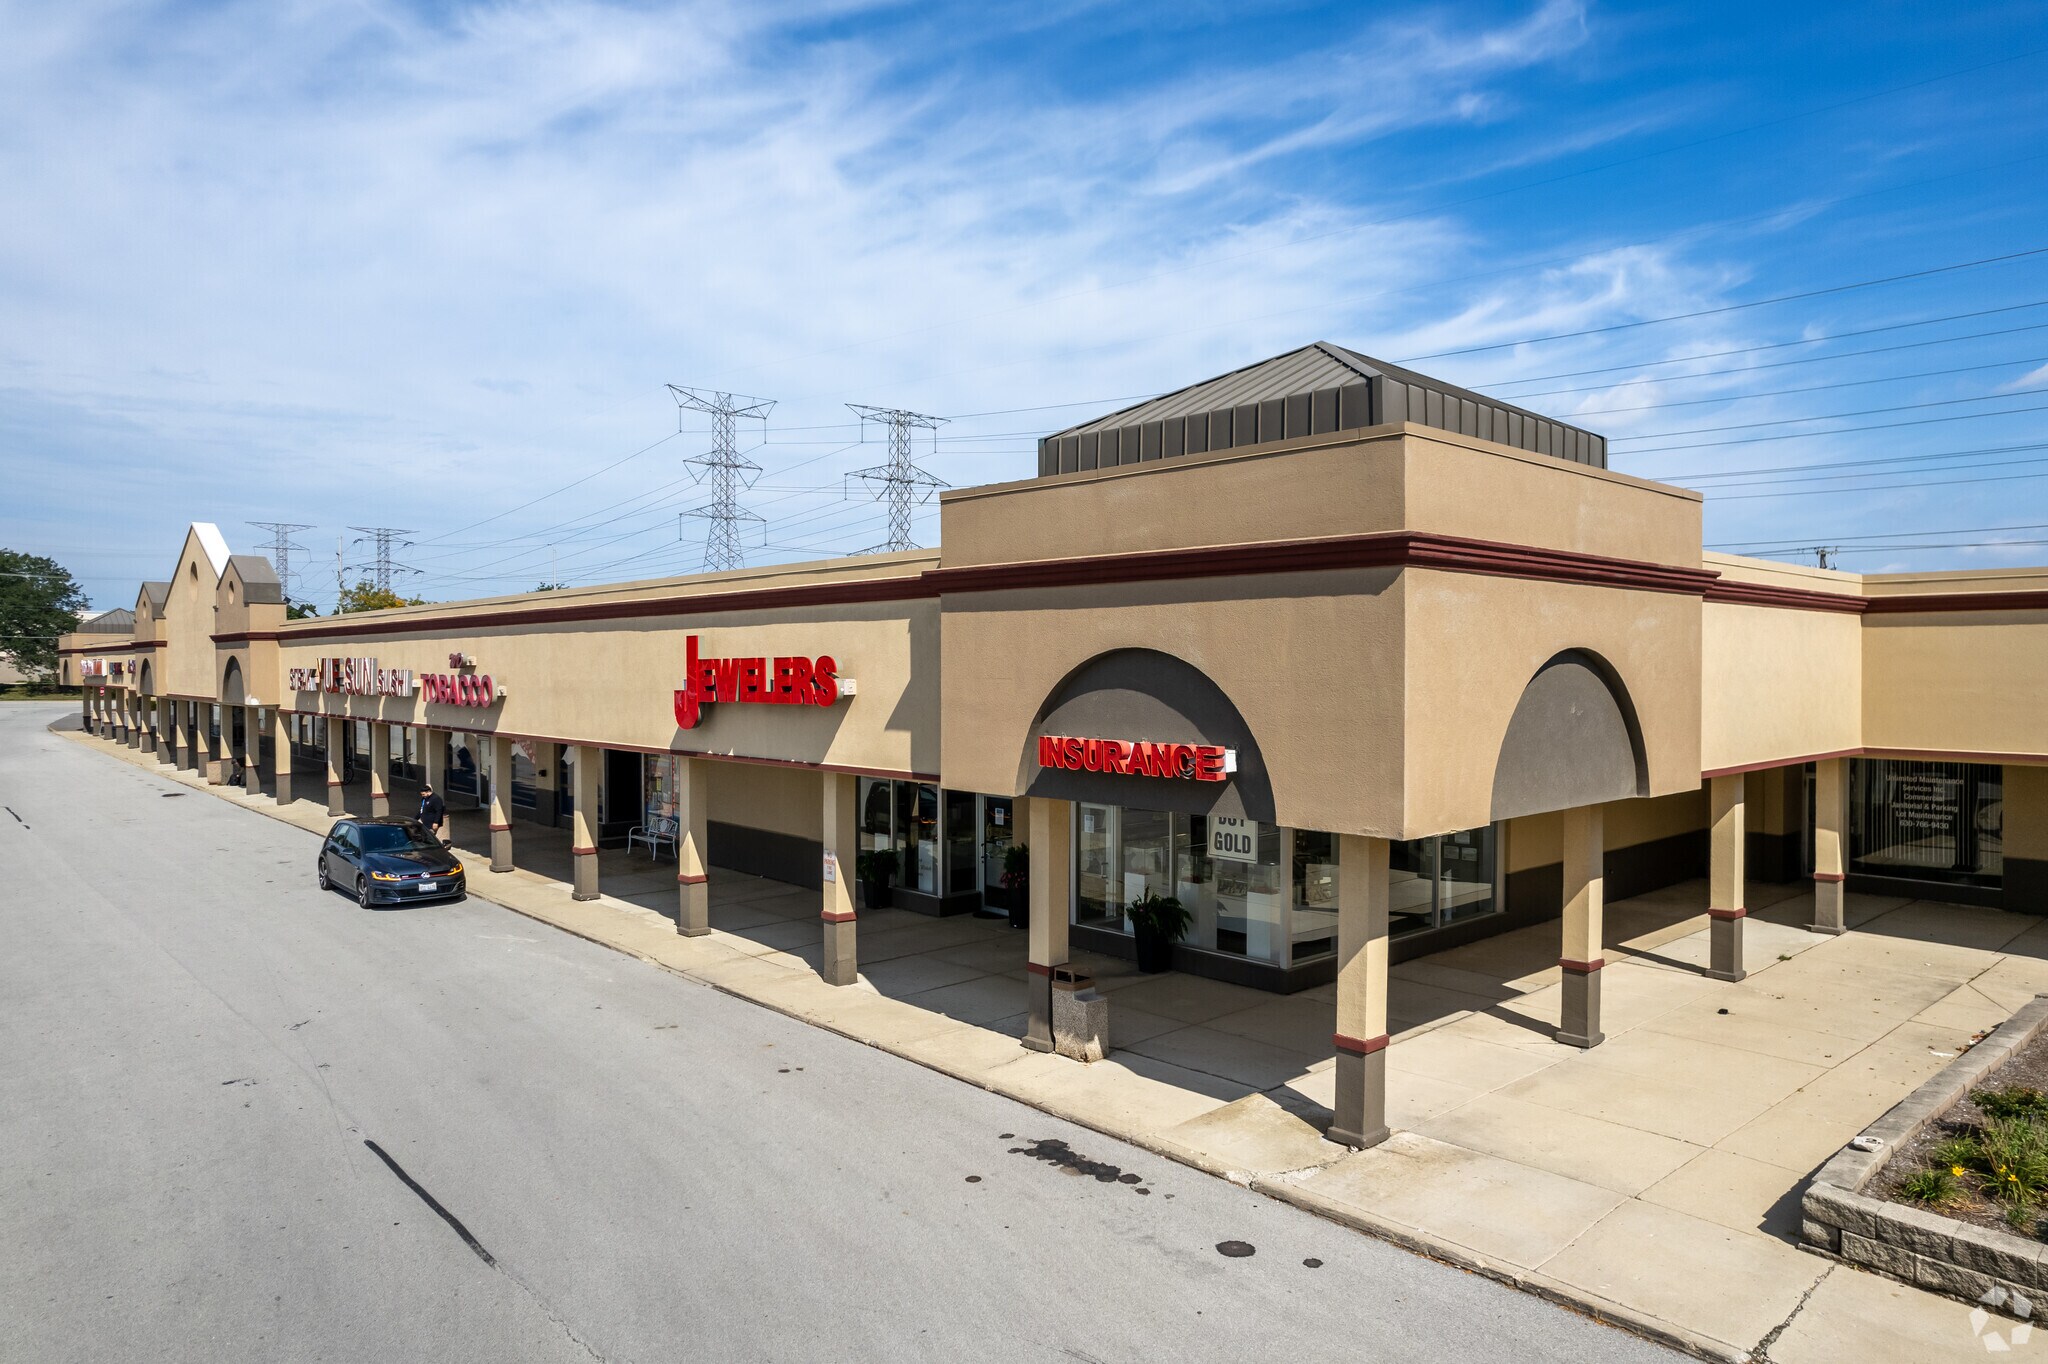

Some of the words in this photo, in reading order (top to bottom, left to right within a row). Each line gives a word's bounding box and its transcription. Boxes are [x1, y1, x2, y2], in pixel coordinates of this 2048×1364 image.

[316, 657, 343, 694] YUE
[344, 657, 376, 695] SUN
[378, 669, 412, 697] SUSHI
[674, 635, 838, 730] JEWELERS
[420, 673, 495, 708] TOBACCO
[1039, 736, 1225, 782] INSURANCE
[1903, 784, 1931, 792] Services
[1919, 776, 1964, 785] Maintenance
[1904, 793, 1944, 801] Commercial
[1891, 802, 1922, 810] Janitorial
[1931, 804, 1958, 812] Parking
[1908, 812, 1952, 820] Maintenance
[1214, 831, 1251, 854] GOLD
